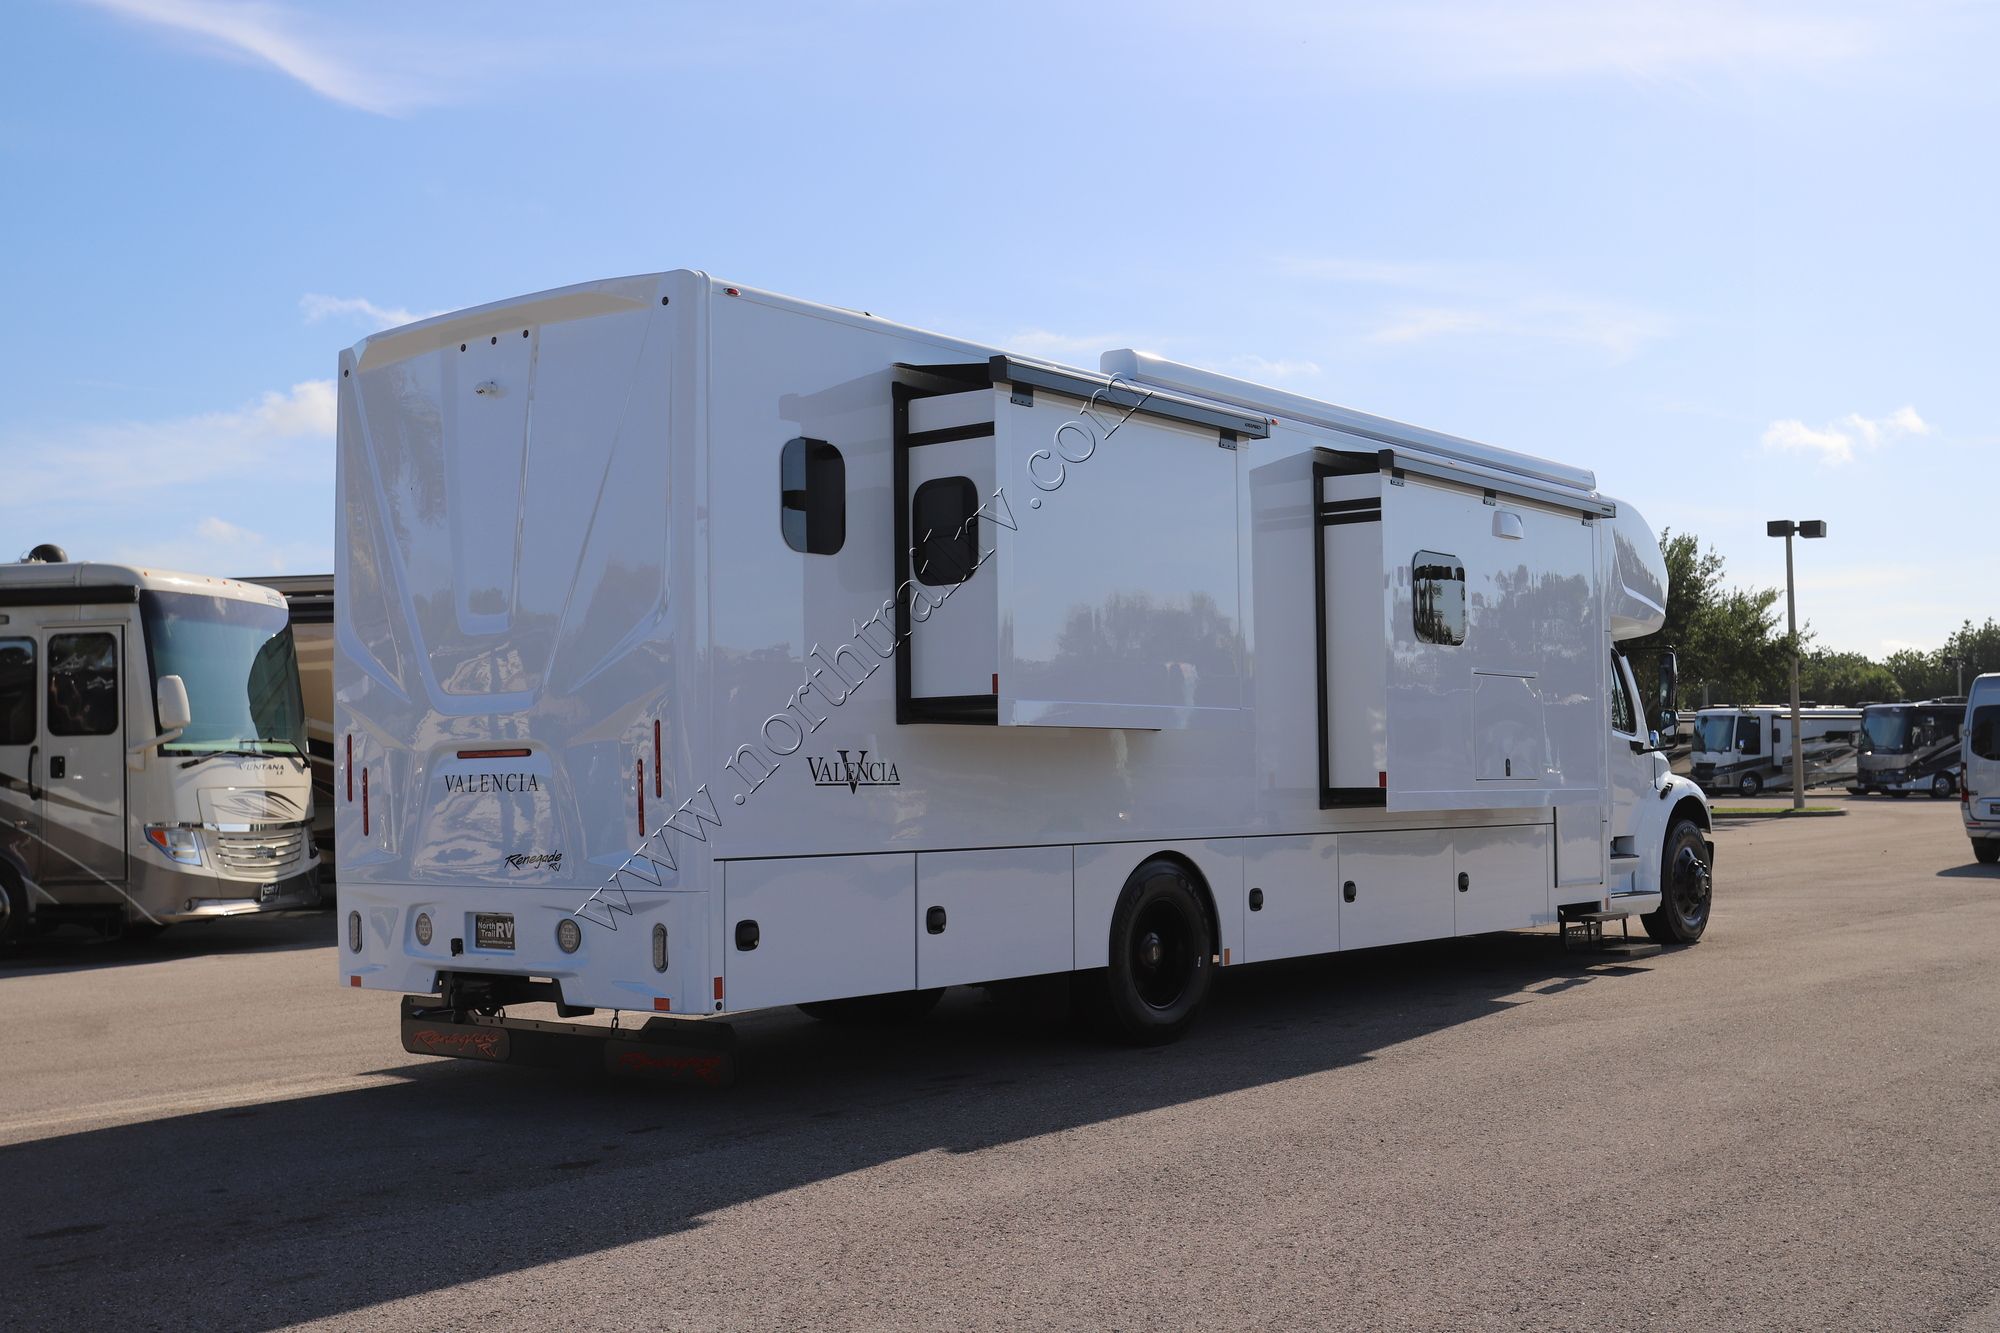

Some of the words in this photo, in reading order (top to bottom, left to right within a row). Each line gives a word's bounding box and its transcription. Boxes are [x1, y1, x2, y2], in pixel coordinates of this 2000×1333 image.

[806, 757, 901, 782] VALENCIA
[445, 773, 540, 793] VALENCIA
[504, 850, 562, 870] Renegade
[478, 921, 496, 930] North
[481, 930, 496, 938] Trail
[496, 921, 514, 938] RV
